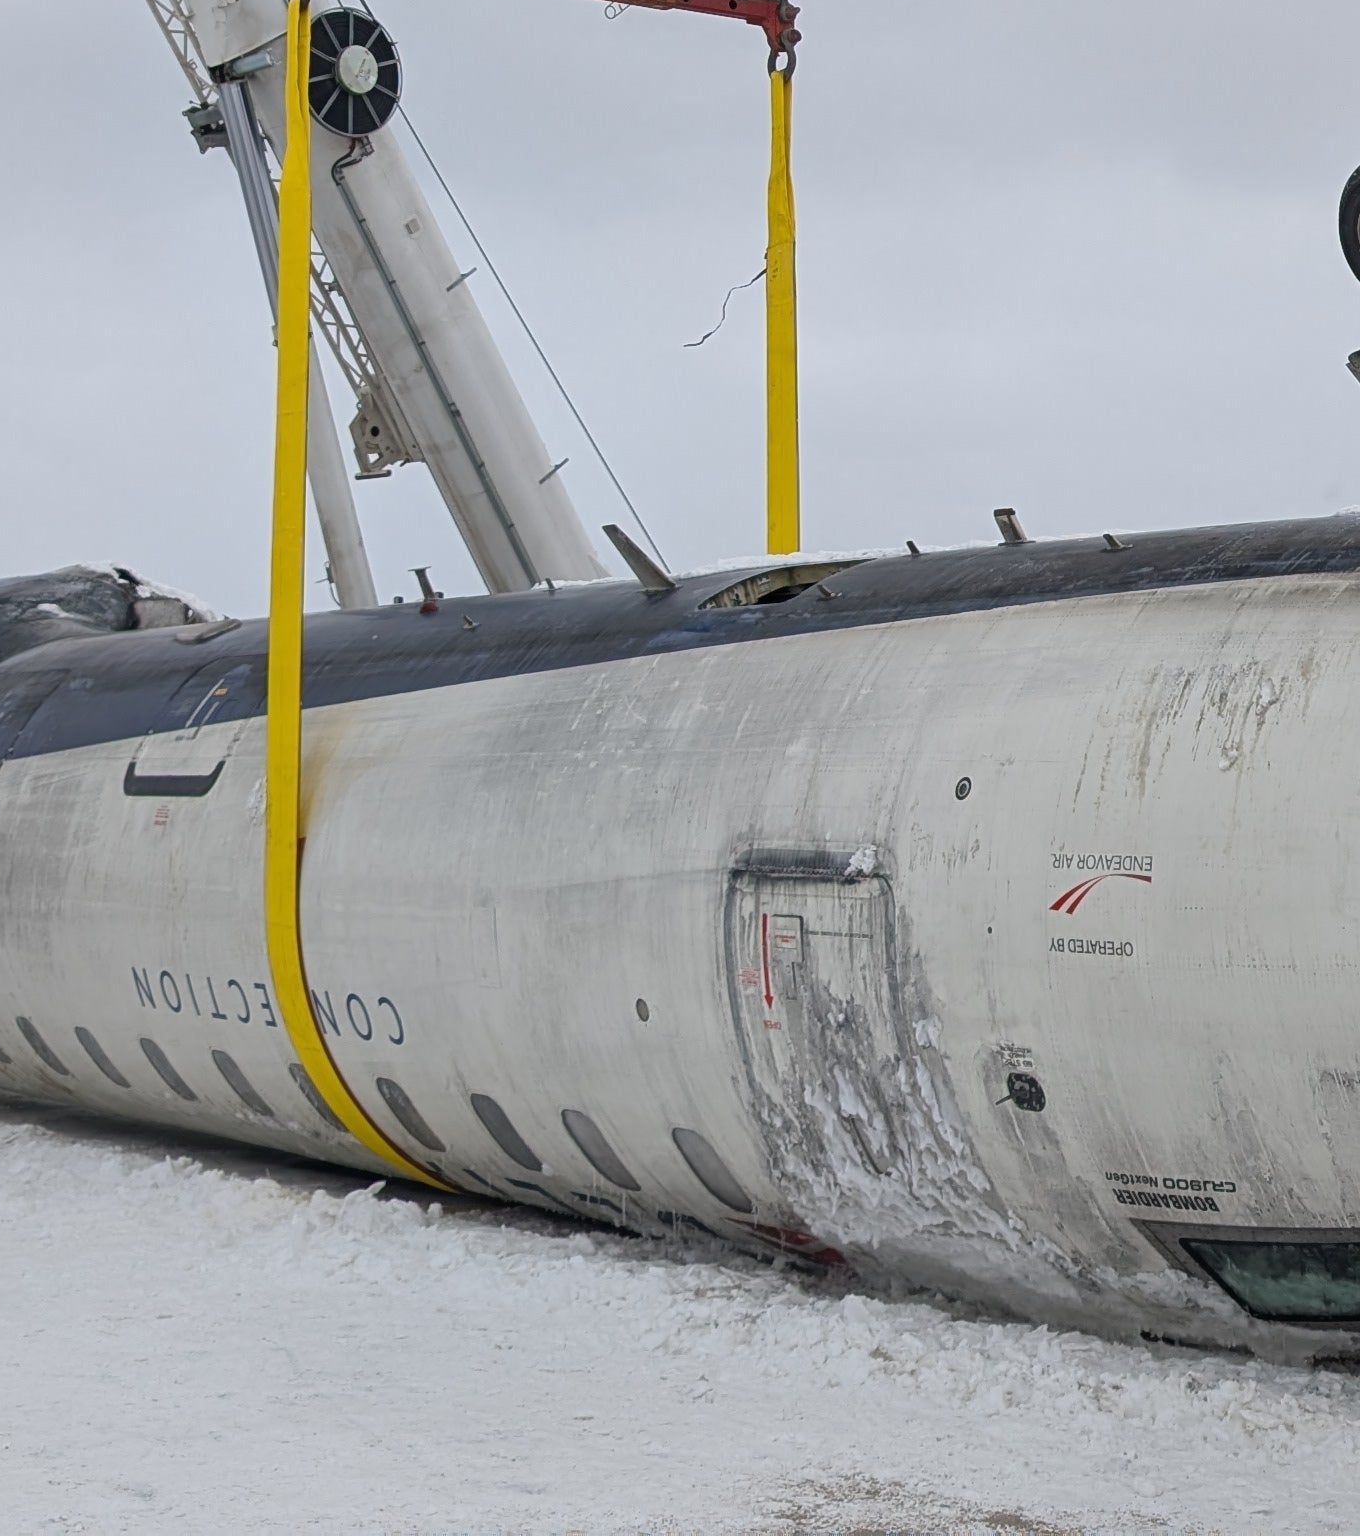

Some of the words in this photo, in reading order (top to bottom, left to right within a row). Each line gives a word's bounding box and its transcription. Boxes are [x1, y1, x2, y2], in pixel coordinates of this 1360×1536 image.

[1076, 854, 1153, 872] ENDEAVOR
[1049, 937, 1065, 953] BY
[1068, 938, 1134, 957] OPERATED
[131, 966, 405, 1046] CONECTION
[1104, 1171, 1159, 1189] NextGen
[1162, 1177, 1237, 1193] CRJ900
[1111, 1188, 1220, 1212] BOMBARDIER
